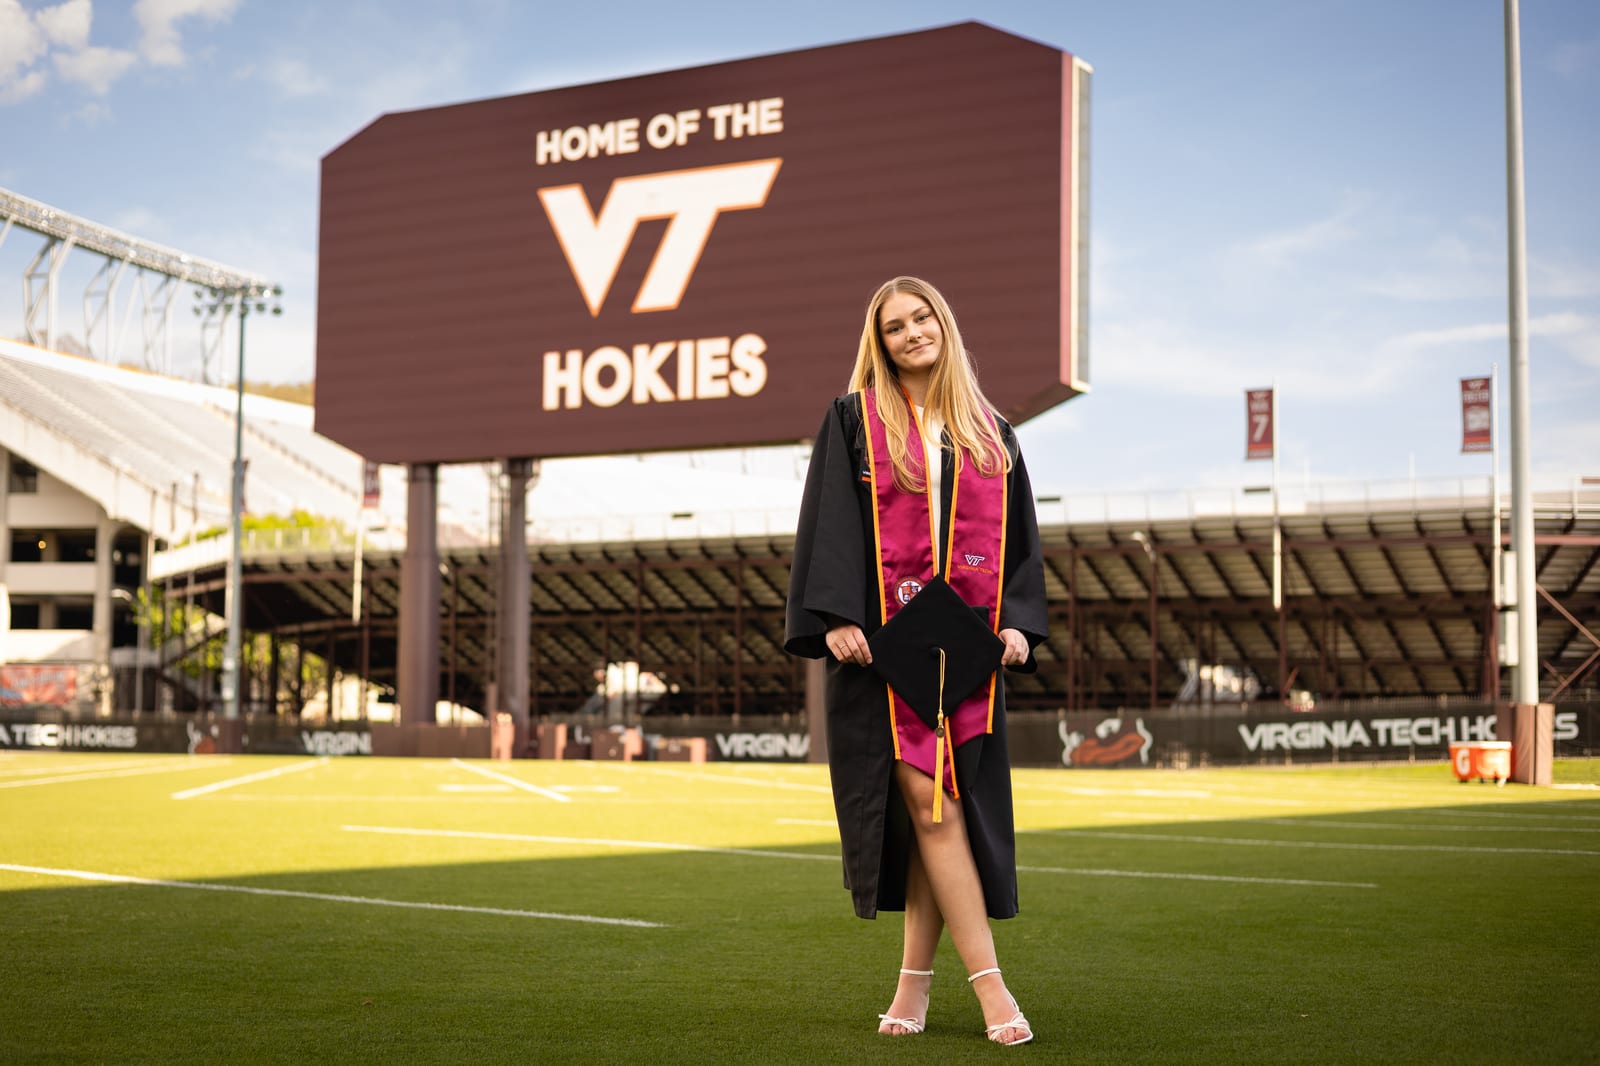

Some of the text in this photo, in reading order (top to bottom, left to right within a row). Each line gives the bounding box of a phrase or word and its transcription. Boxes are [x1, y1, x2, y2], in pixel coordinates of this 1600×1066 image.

[536, 97, 784, 165] HOME OF THE
[536, 157, 784, 318] VT
[542, 333, 768, 411] HOKIES
[1252, 414, 1270, 443] 7
[964, 554, 985, 566] VT
[10, 723, 73, 747] TECH
[1238, 719, 1370, 751] VIRGINIA
[1371, 715, 1456, 747] TECH
[1456, 748, 1471, 776] G
